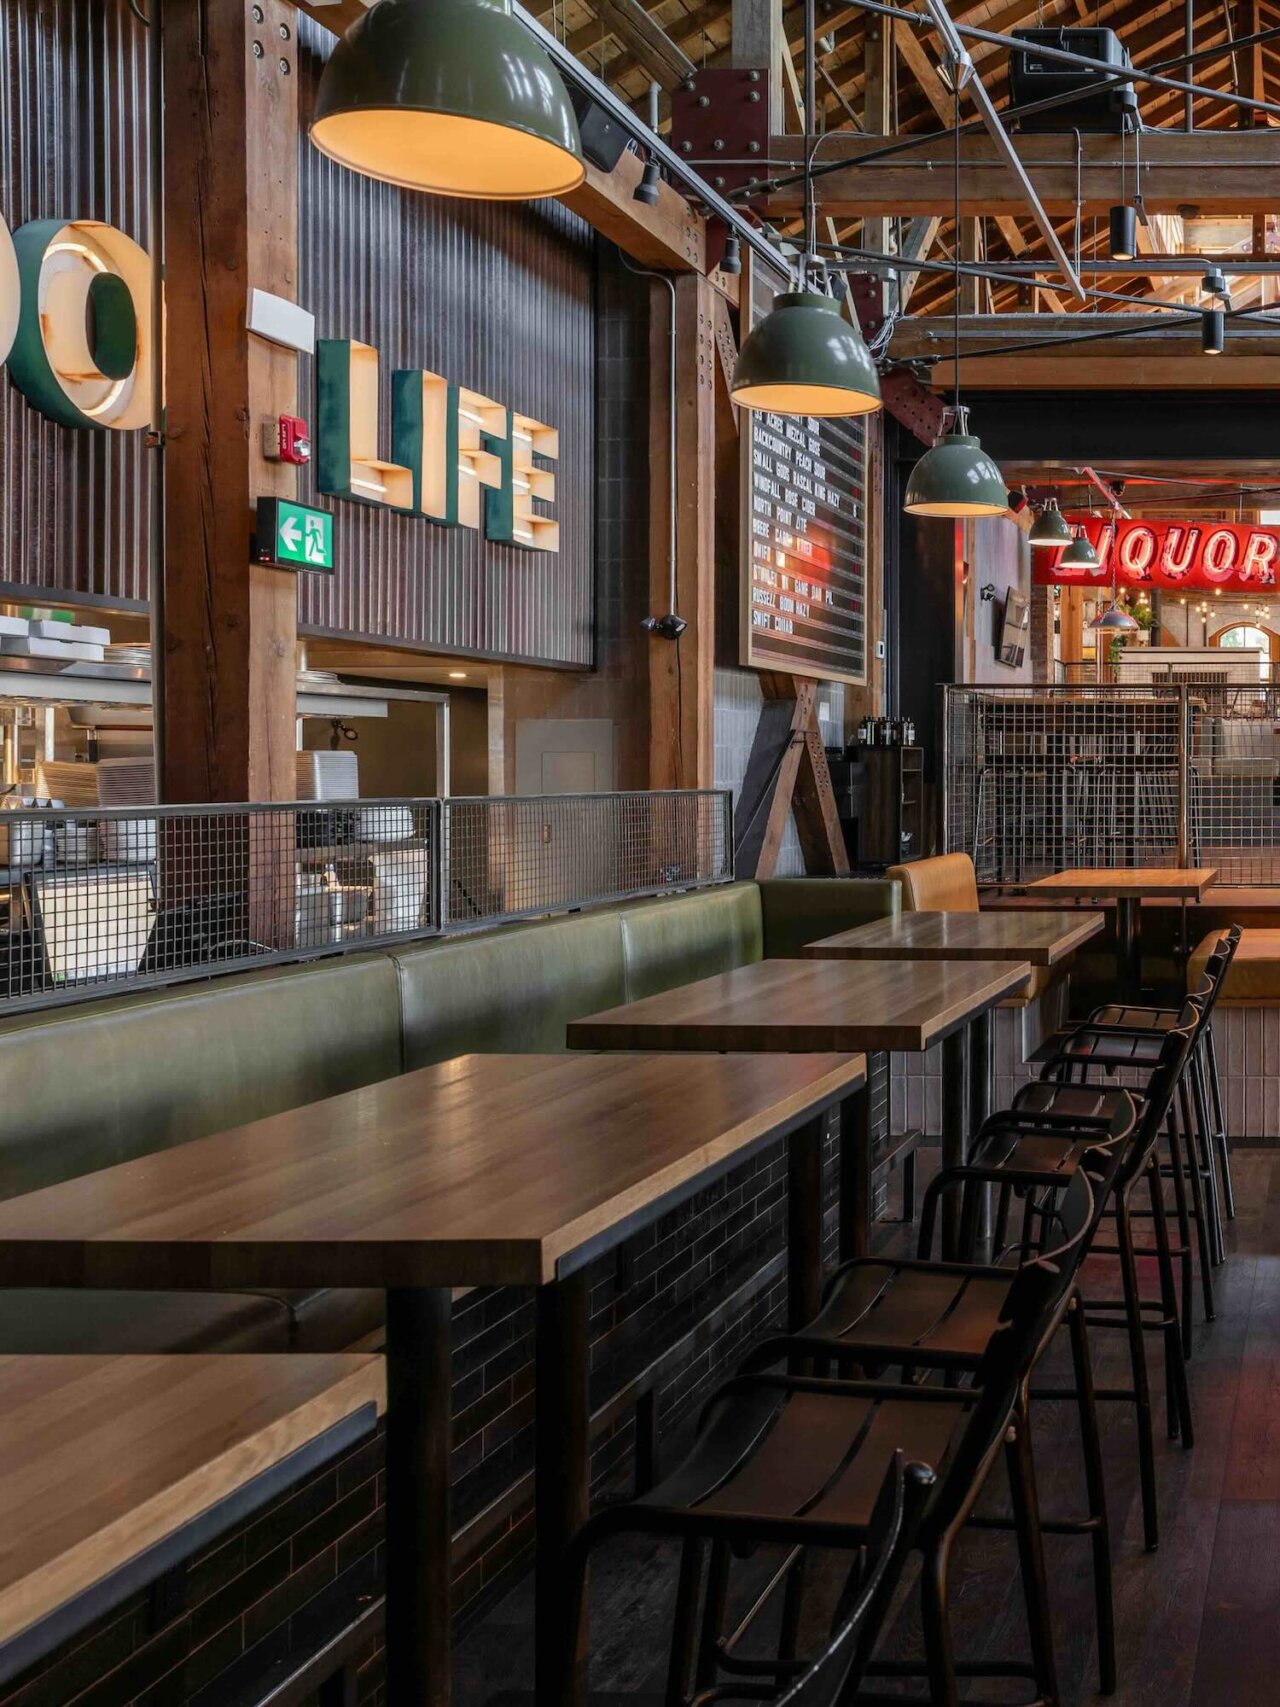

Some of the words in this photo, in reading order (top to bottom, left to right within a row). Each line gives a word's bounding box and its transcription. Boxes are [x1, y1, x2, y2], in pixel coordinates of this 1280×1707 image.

[318, 339, 560, 552] LIFE
[754, 425, 792, 461] BACKCOUNTRY
[795, 450, 812, 473] PEACH
[813, 461, 826, 481] SOUR
[766, 413, 784, 434] ACRES
[786, 422, 807, 448] MEZCAL
[754, 449, 773, 473] SMALL
[793, 470, 813, 495] RASCAL
[827, 489, 840, 509] HAZY
[754, 472, 781, 500] WINDFALL
[801, 496, 816, 517] CIDER
[754, 494, 772, 517] NORTH
[776, 505, 792, 526] POINT
[753, 610, 771, 629] SWIFT
